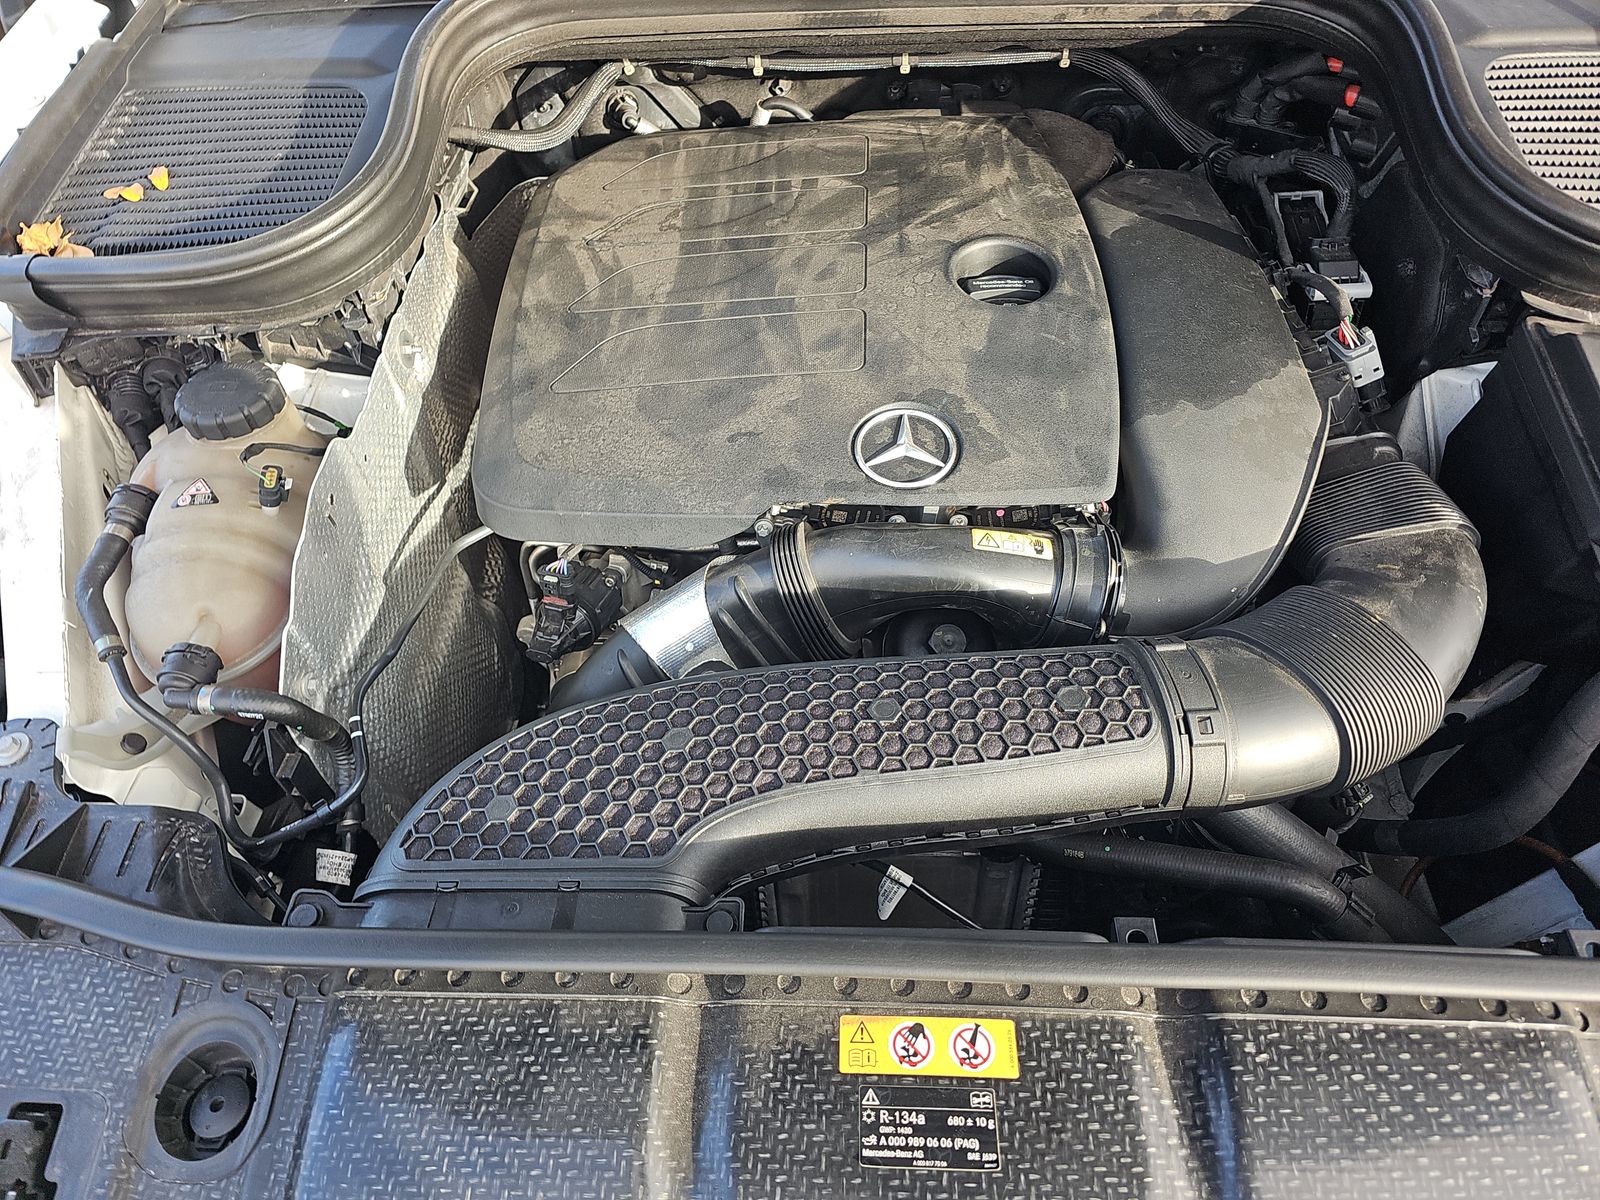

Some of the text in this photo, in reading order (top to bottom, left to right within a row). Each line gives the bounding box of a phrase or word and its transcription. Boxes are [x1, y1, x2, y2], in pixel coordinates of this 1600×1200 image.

[880, 1110, 926, 1125] R-134a
[947, 1116, 965, 1126] 680
[976, 1117, 986, 1128] 10
[988, 1119, 995, 1130] g
[879, 1136, 980, 1150] A 000 989 06 06 (PAG)
[862, 1148, 924, 1159] Mercedes-Benz AG
